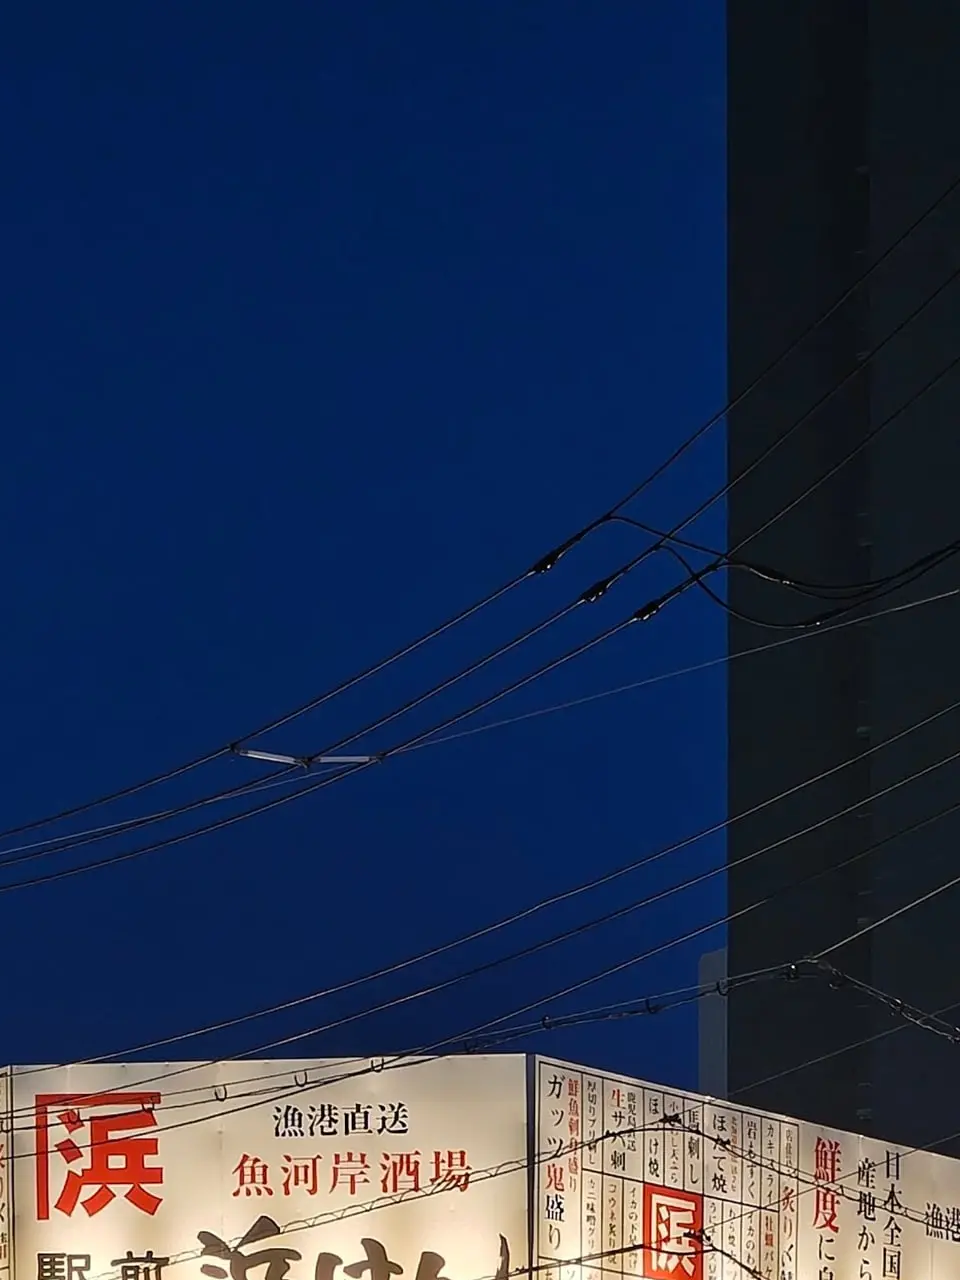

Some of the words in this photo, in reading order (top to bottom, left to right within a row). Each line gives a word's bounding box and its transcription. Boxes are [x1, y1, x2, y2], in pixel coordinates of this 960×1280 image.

[35, 1092, 163, 1221] 浜
[272, 1102, 410, 1138] 漁港直送
[544, 1074, 566, 1251] ガッツ鬼盛り
[232, 1150, 472, 1198] 魚河岸酒場
